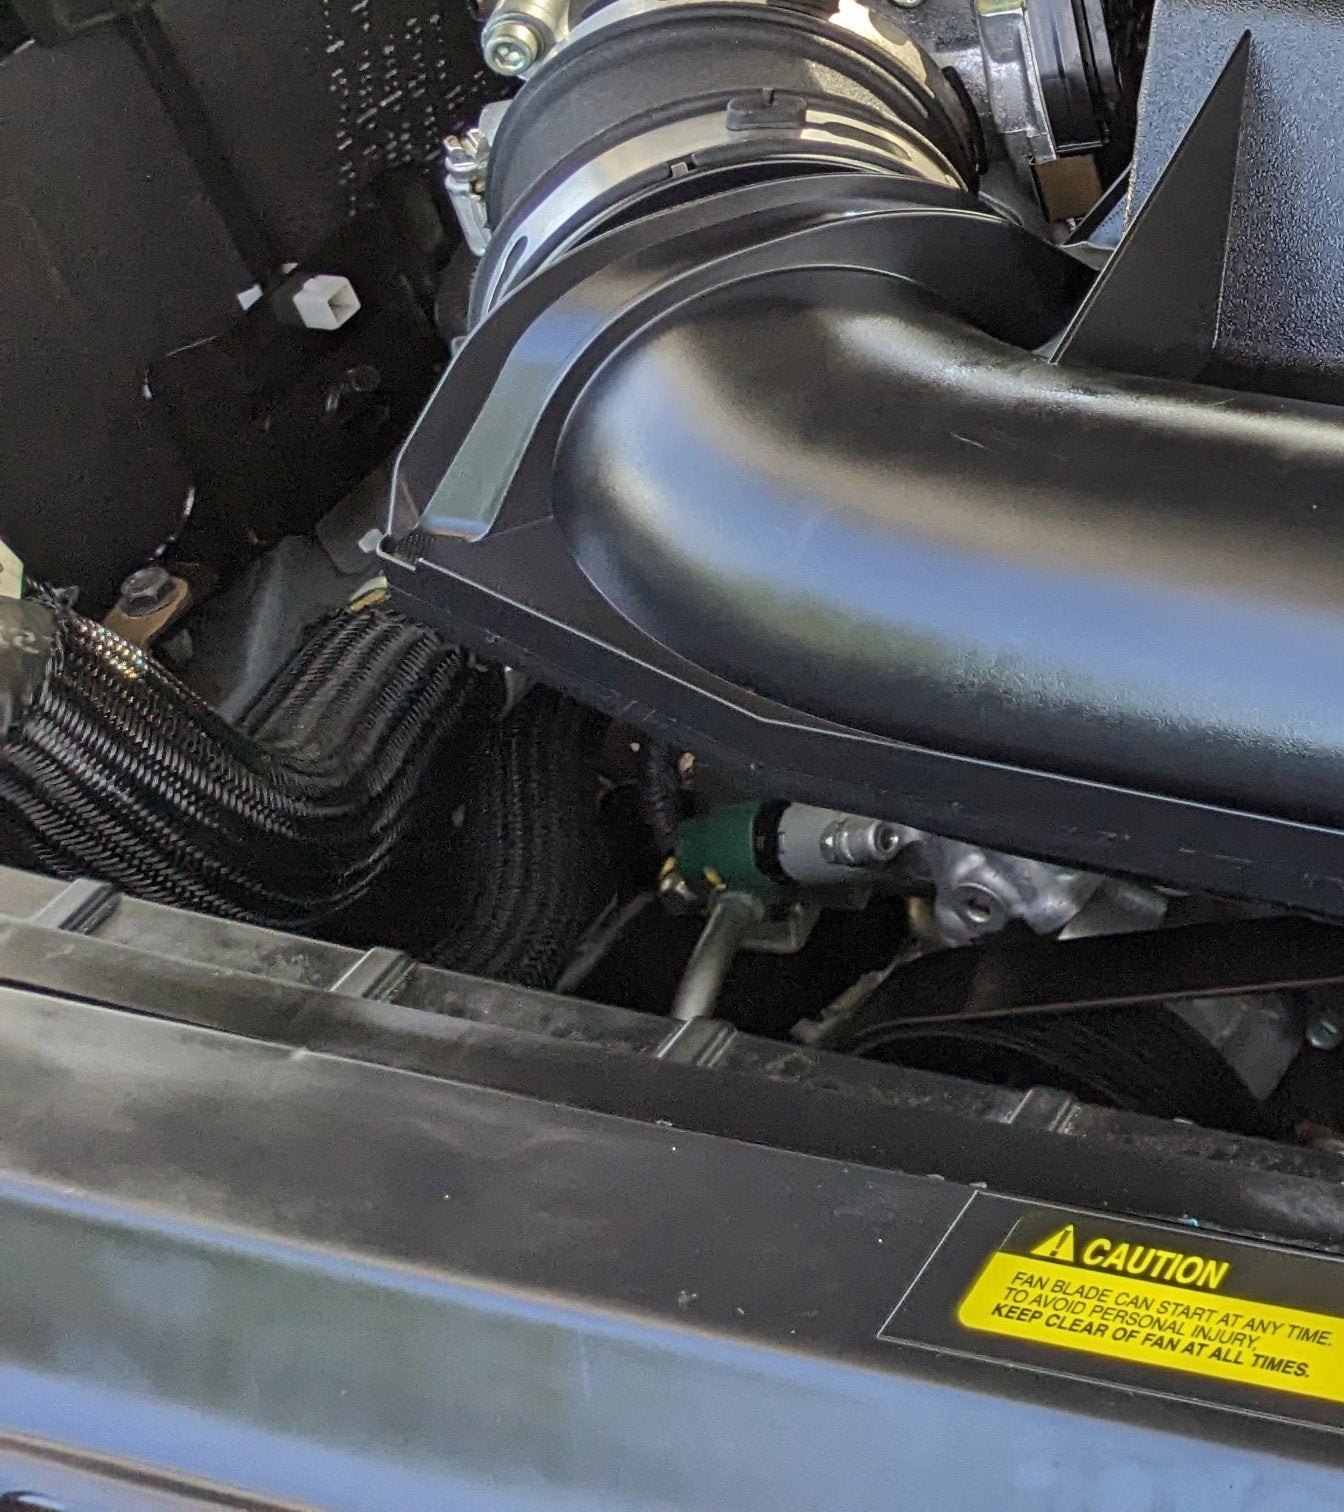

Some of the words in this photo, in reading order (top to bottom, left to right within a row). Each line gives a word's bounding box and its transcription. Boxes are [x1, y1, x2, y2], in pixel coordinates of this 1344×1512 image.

[1083, 1238, 1230, 1289] CAUTION
[991, 1303, 1043, 1324] KEEP
[1044, 1314, 1107, 1338] CLEAR
[1111, 1326, 1139, 1343] OF
[1139, 1332, 1180, 1352] FAN
[1182, 1341, 1207, 1357] AT
[1208, 1346, 1244, 1366] ALL
[1252, 1353, 1311, 1379] TIMES.
[1004, 1287, 1029, 1304] TO
[1028, 1293, 1087, 1316] AVOID
[1091, 1305, 1186, 1338] PERSONAL
[1011, 1272, 1048, 1292] FAN
[1050, 1280, 1109, 1303] BLADE
[1114, 1292, 1154, 1311] CAN
[1156, 1300, 1218, 1324] START
[1219, 1312, 1244, 1328] AT
[1243, 1316, 1287, 1334] ANY
[1288, 1325, 1332, 1347] TIME.
